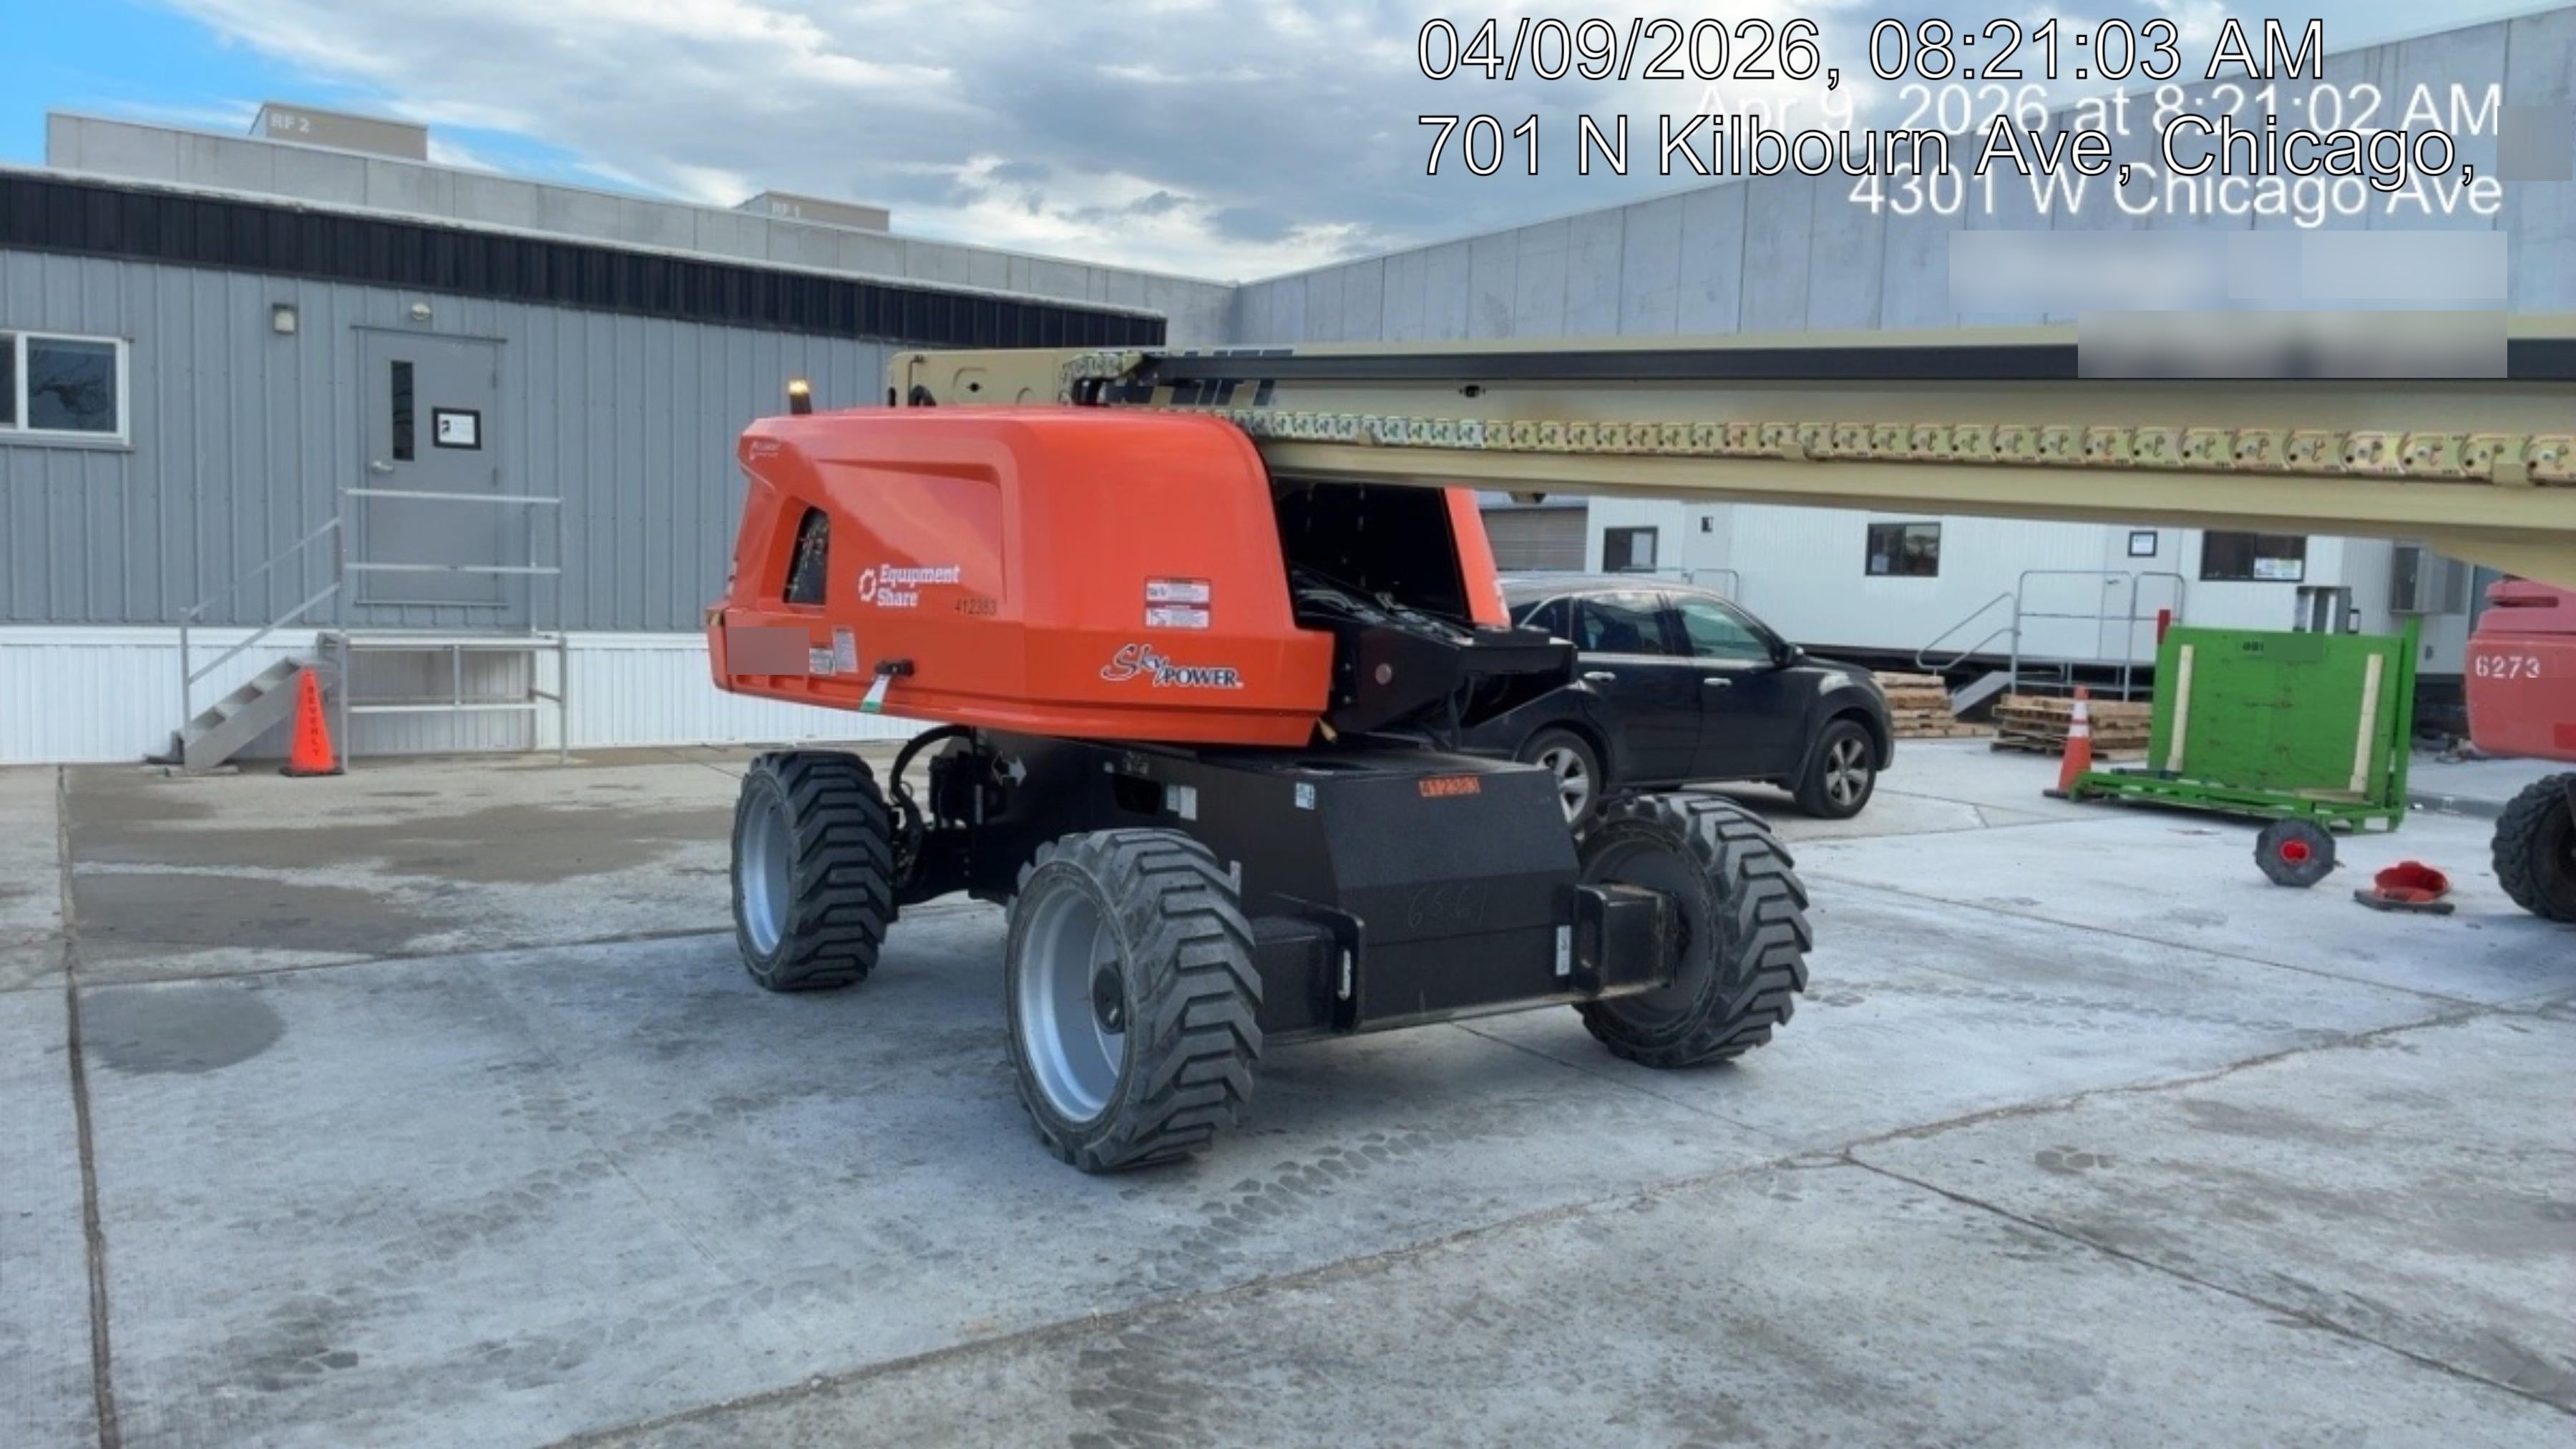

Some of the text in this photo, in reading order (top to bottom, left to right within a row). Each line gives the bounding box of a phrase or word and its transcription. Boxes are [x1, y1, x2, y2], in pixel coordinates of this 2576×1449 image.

[271, 114, 310, 132] RF 2
[880, 564, 960, 588] Equipment
[877, 587, 919, 607] Share
[2476, 655, 2540, 678] 6273
